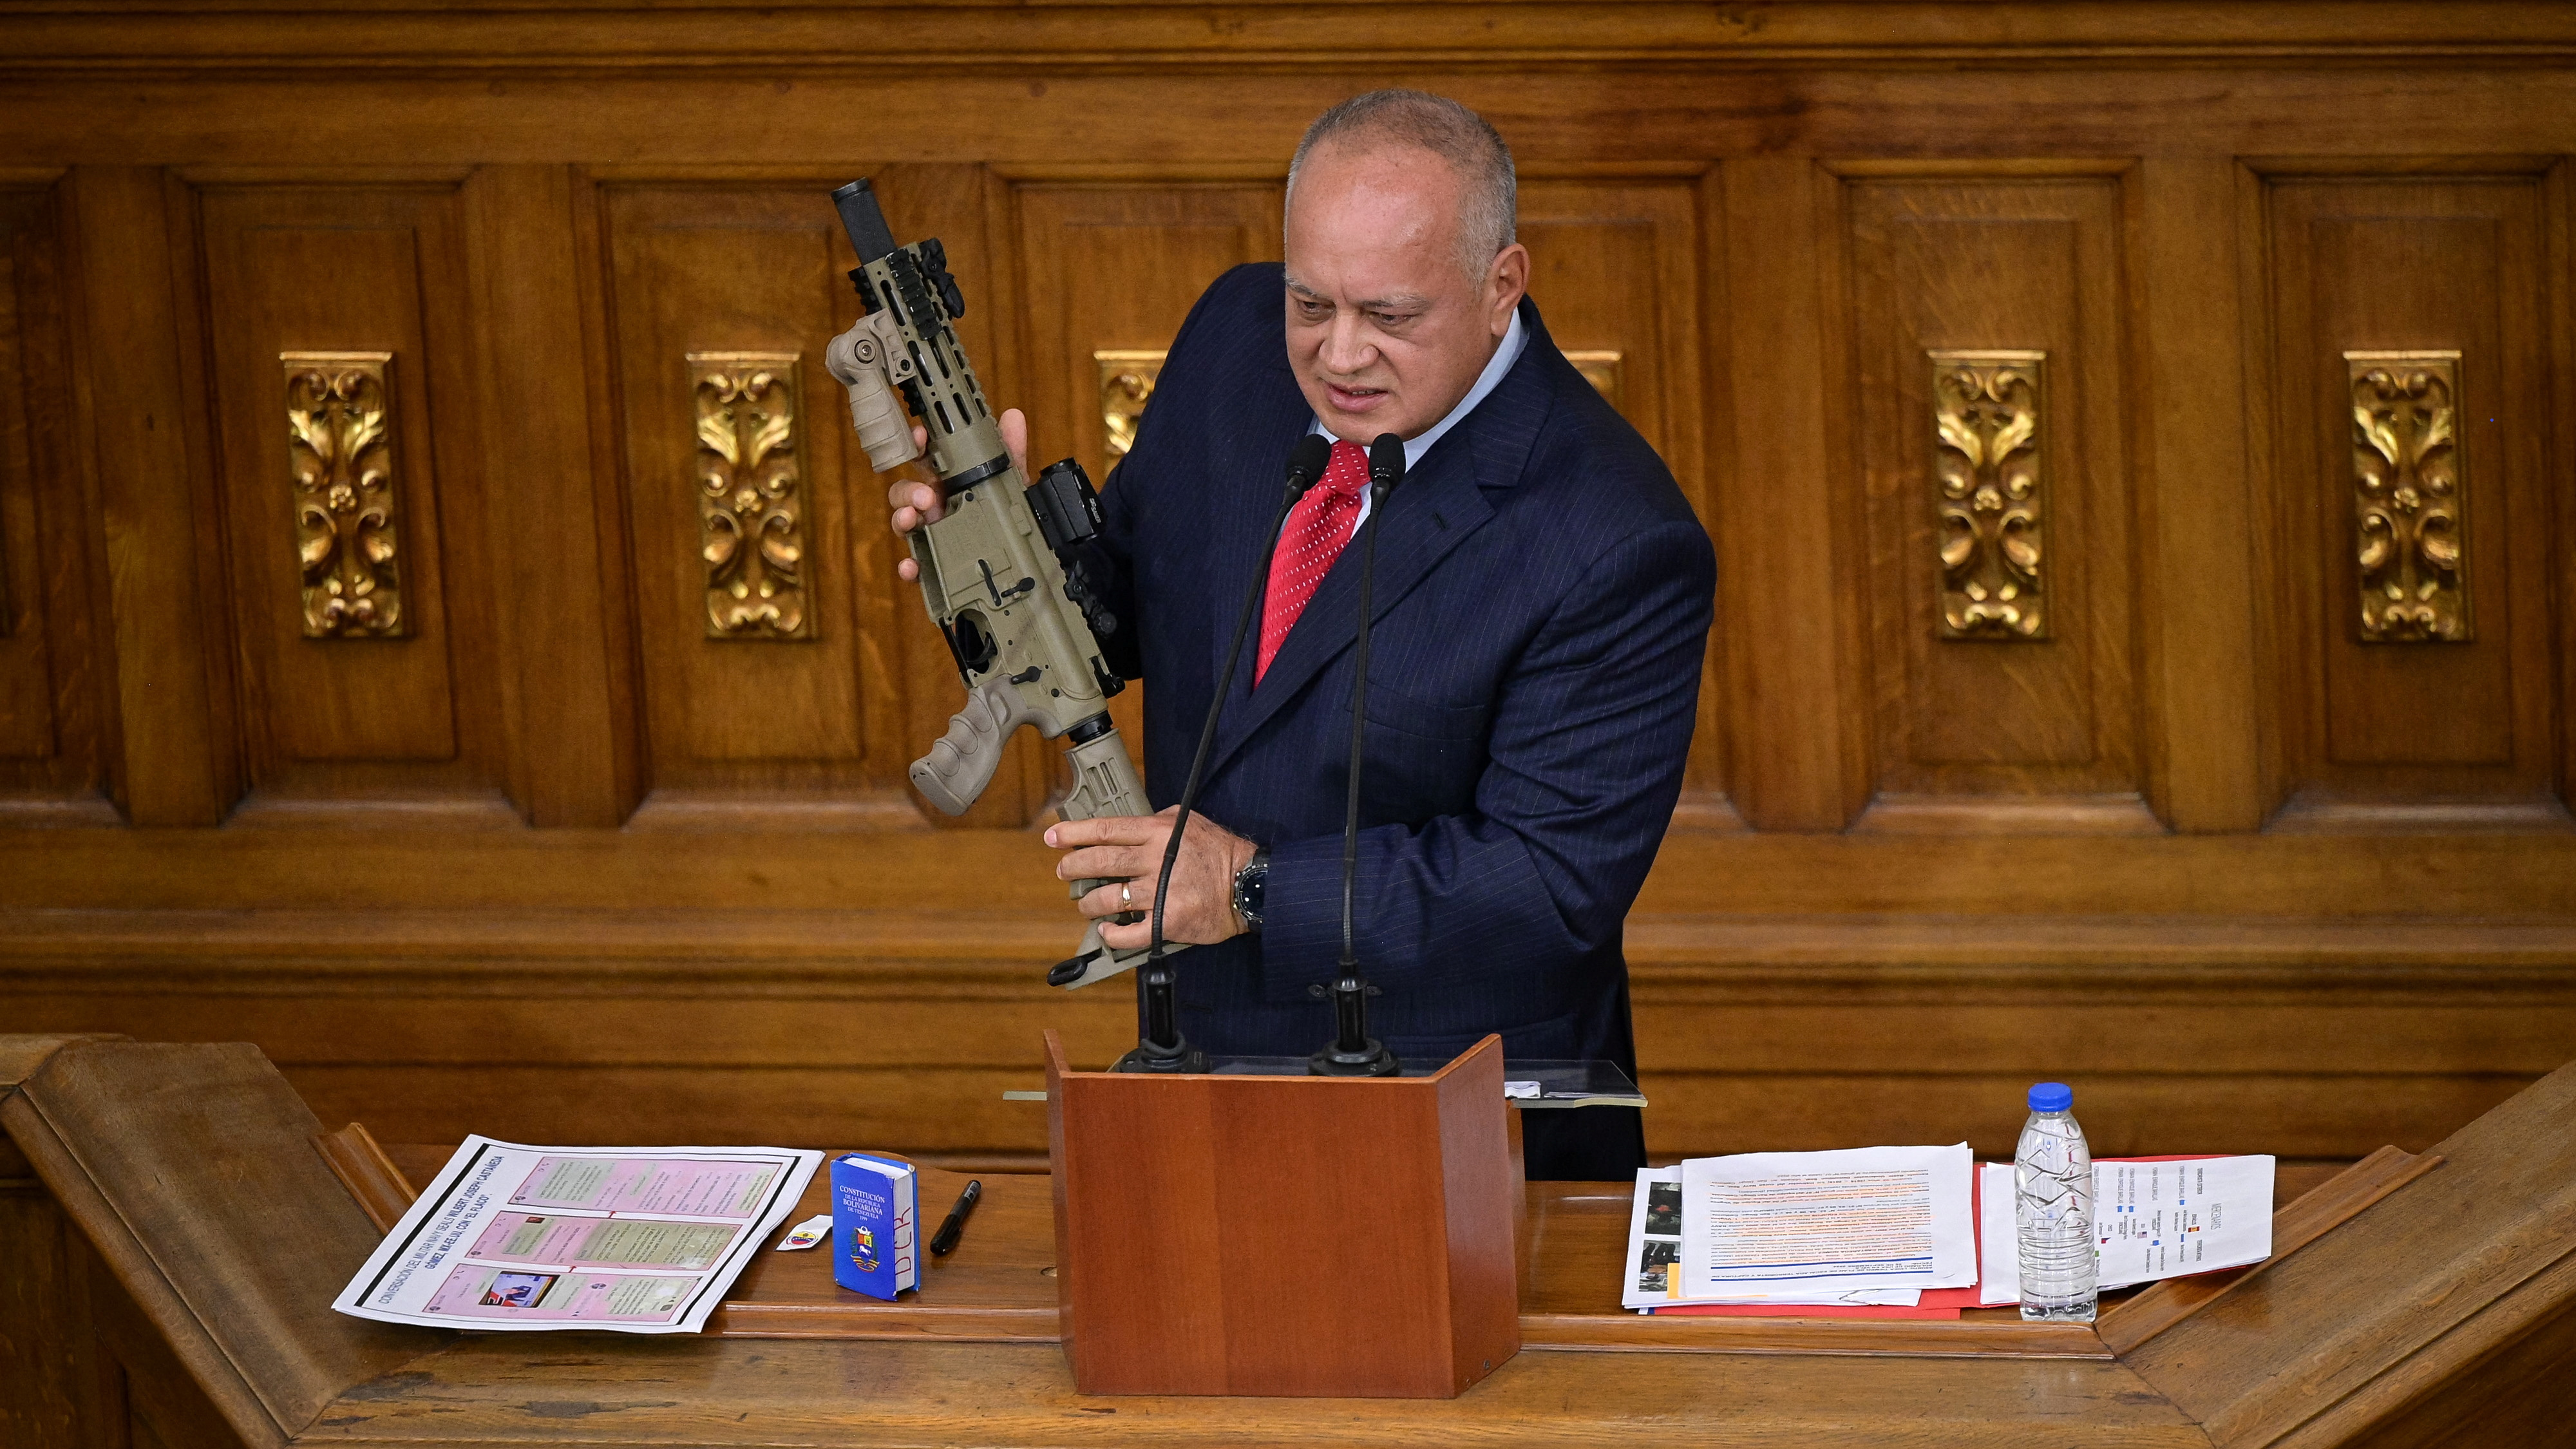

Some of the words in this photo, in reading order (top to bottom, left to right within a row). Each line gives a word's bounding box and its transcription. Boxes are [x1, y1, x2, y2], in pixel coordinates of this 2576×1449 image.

[840, 1185, 886, 1203] CONSTITUCIÓN
[843, 1198, 883, 1215] BOLIVARIANA
[406, 1260, 421, 1269] DEL
[447, 1198, 469, 1217] WILBERT
[463, 1181, 484, 1198] JOSEPH
[456, 1220, 470, 1229] CON
